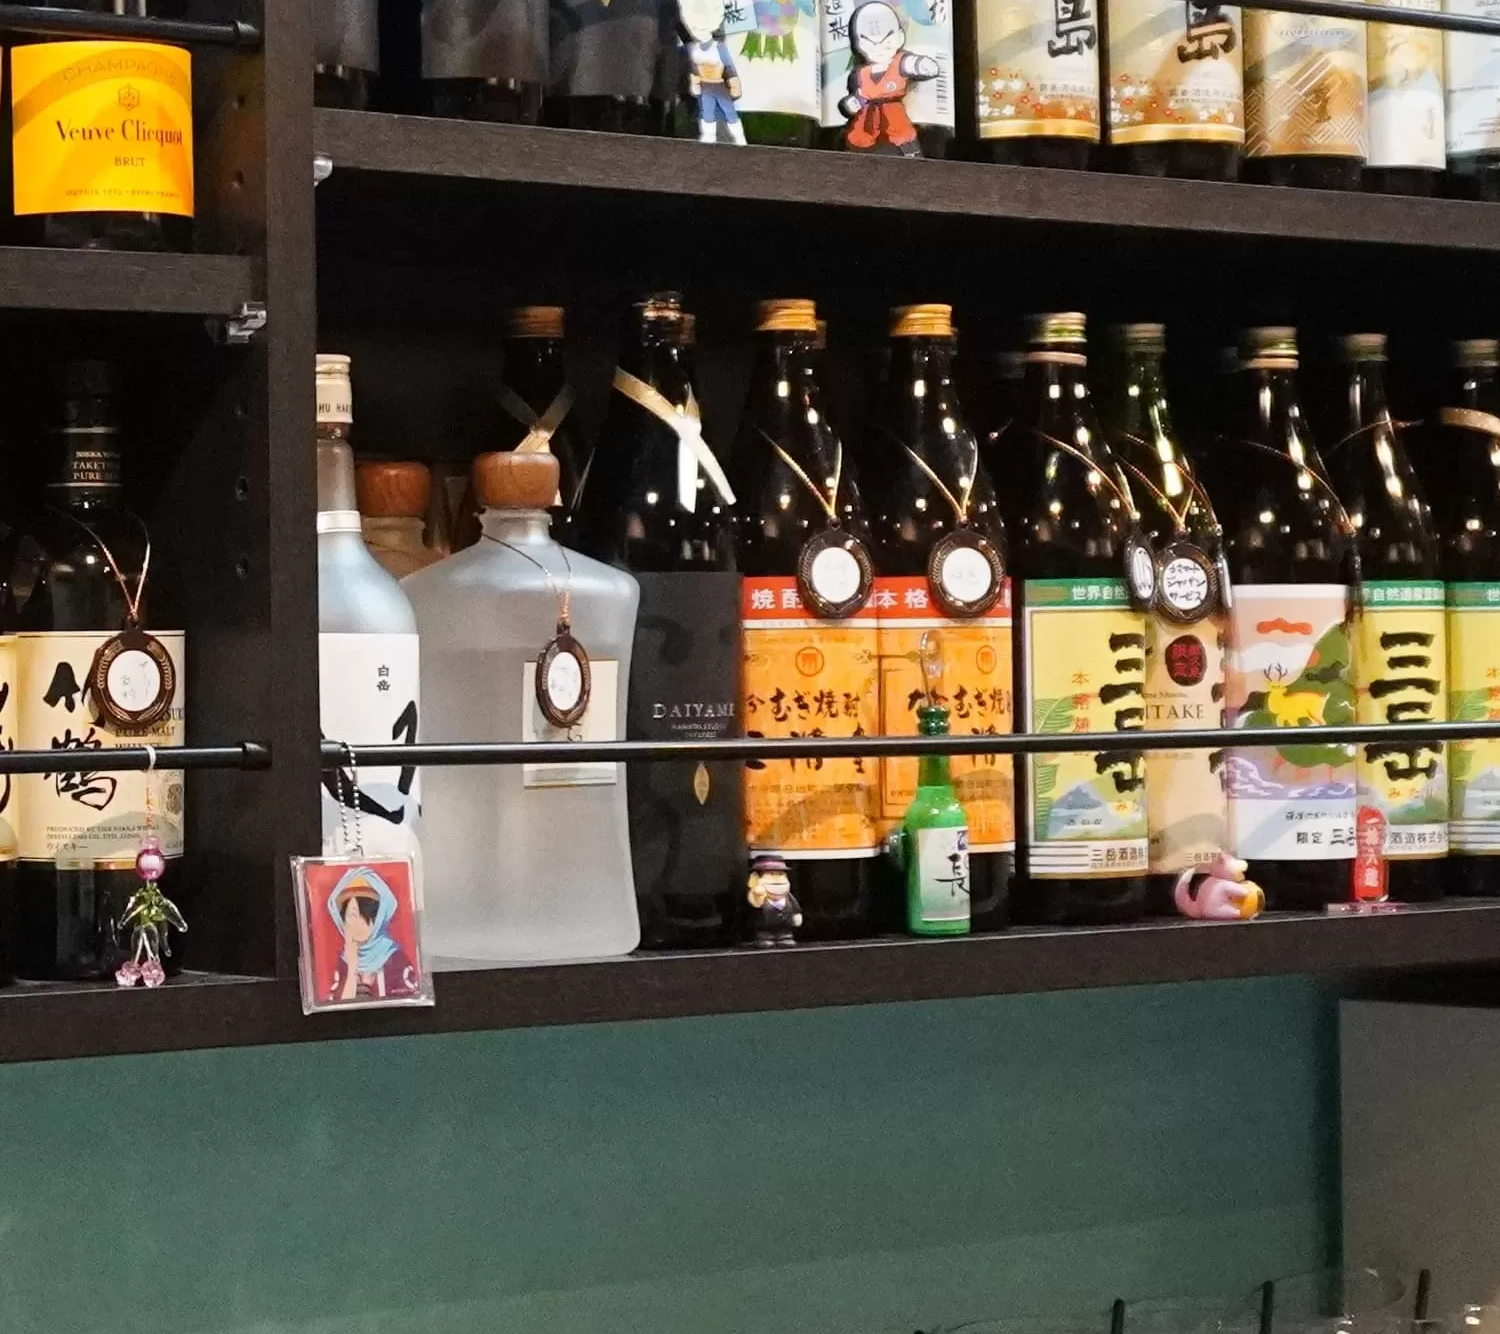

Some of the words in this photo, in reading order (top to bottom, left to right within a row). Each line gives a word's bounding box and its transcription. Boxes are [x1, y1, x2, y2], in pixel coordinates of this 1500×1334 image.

[62, 58, 179, 86] CHAMPAGNE
[55, 119, 115, 142] Veuve
[121, 118, 184, 148] Clicquot
[113, 155, 146, 169] BRUT
